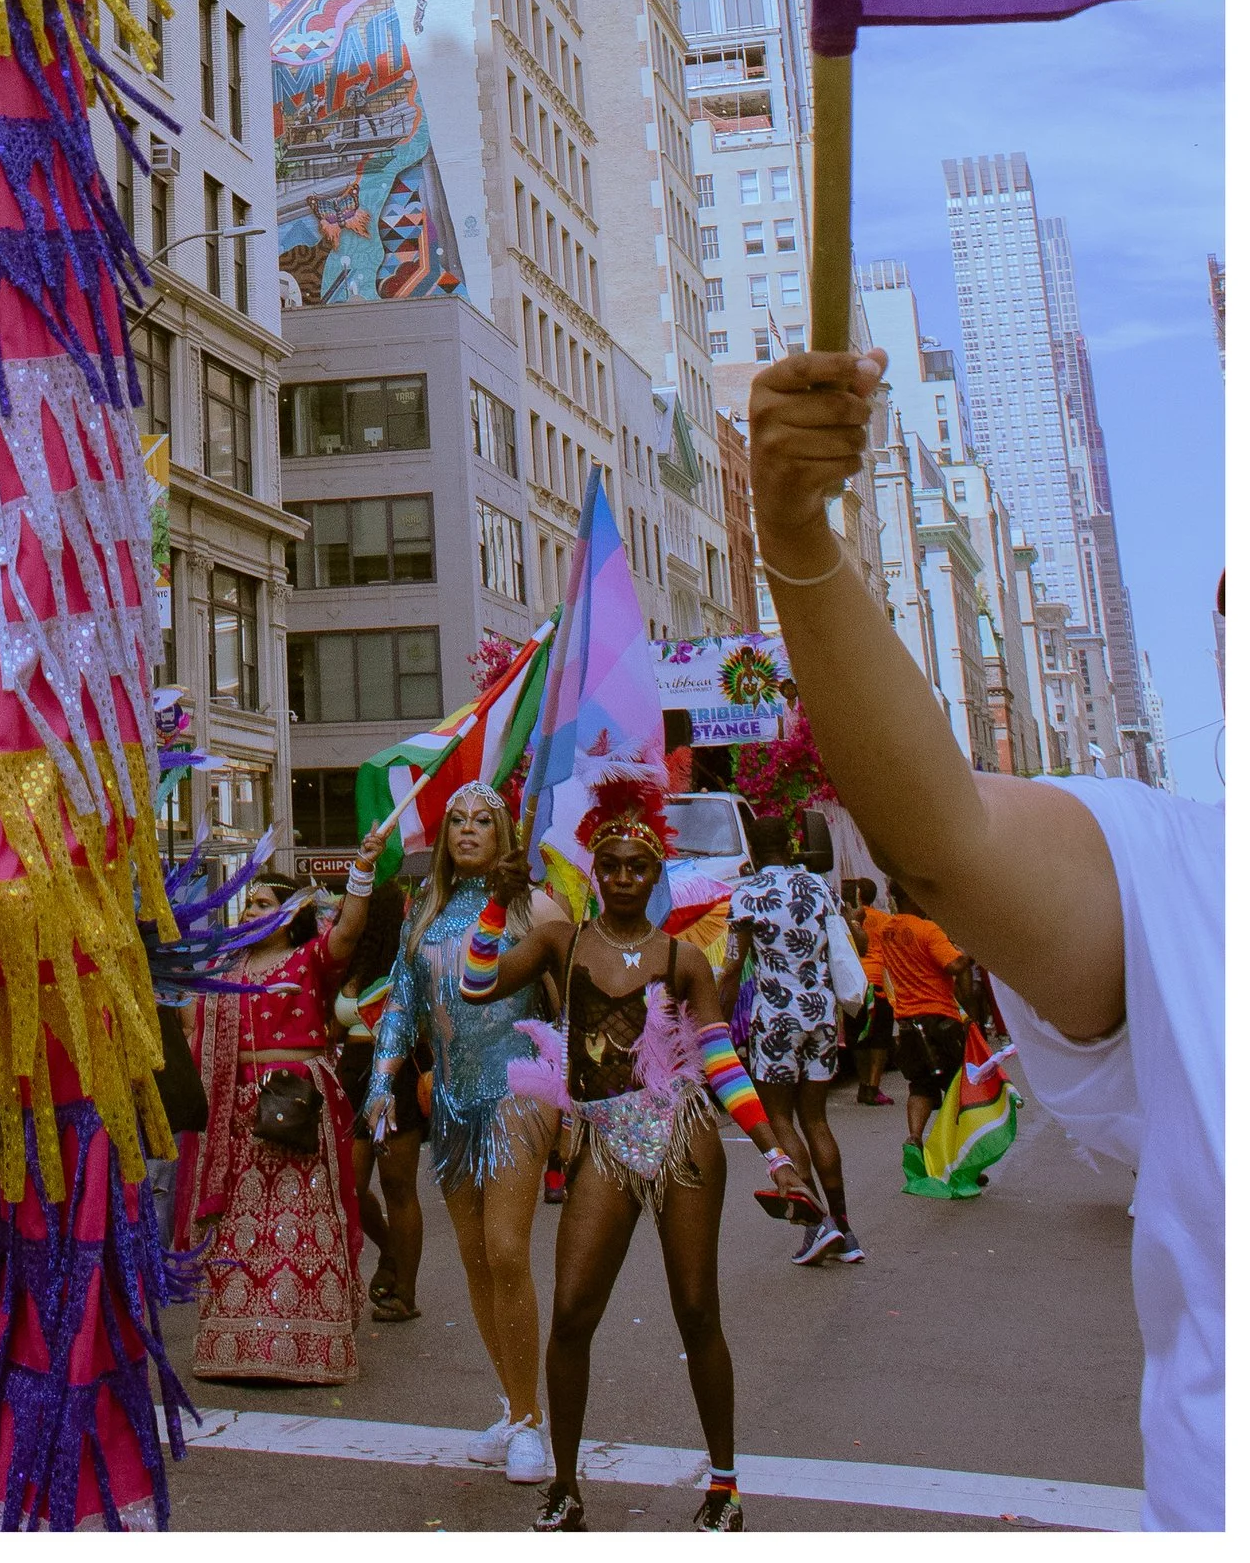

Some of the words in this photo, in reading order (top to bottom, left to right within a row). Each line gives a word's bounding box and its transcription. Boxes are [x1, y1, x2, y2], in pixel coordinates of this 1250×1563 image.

[691, 702, 784, 723] ERIBBEAN
[692, 721, 761, 739] STANCE
[313, 859, 358, 872] CHIPO
